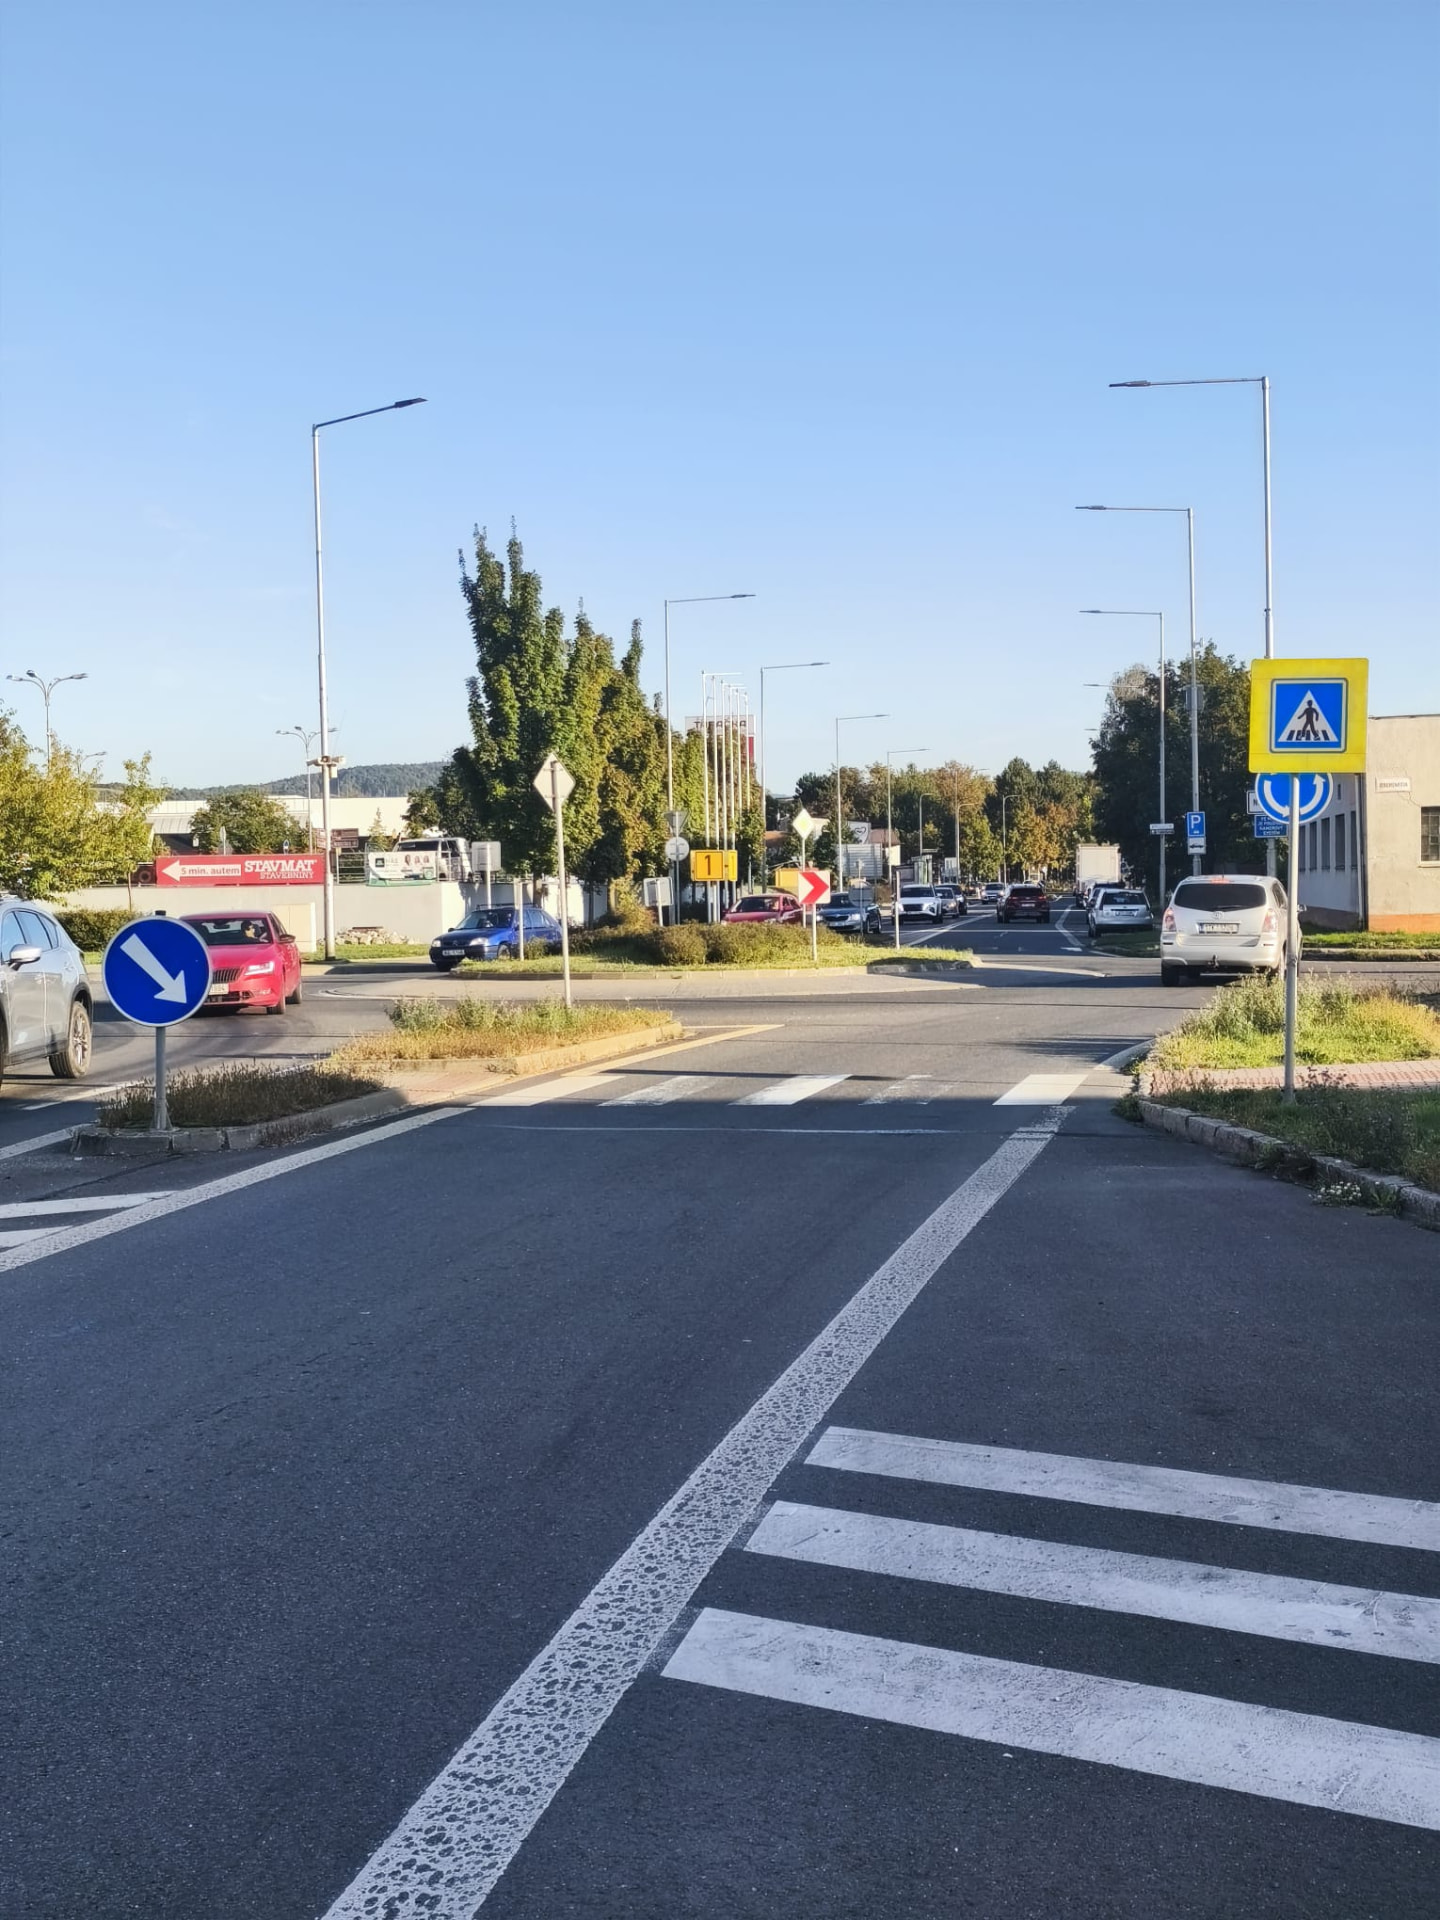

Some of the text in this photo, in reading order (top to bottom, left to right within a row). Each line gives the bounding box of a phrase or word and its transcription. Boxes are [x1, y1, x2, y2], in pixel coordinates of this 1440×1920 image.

[1191, 815, 1201, 828] P
[181, 866, 240, 876] 5 min. autem
[244, 859, 315, 872] STAVMAT
[704, 854, 711, 876] 1
[260, 870, 314, 880] STAVEBNINY
